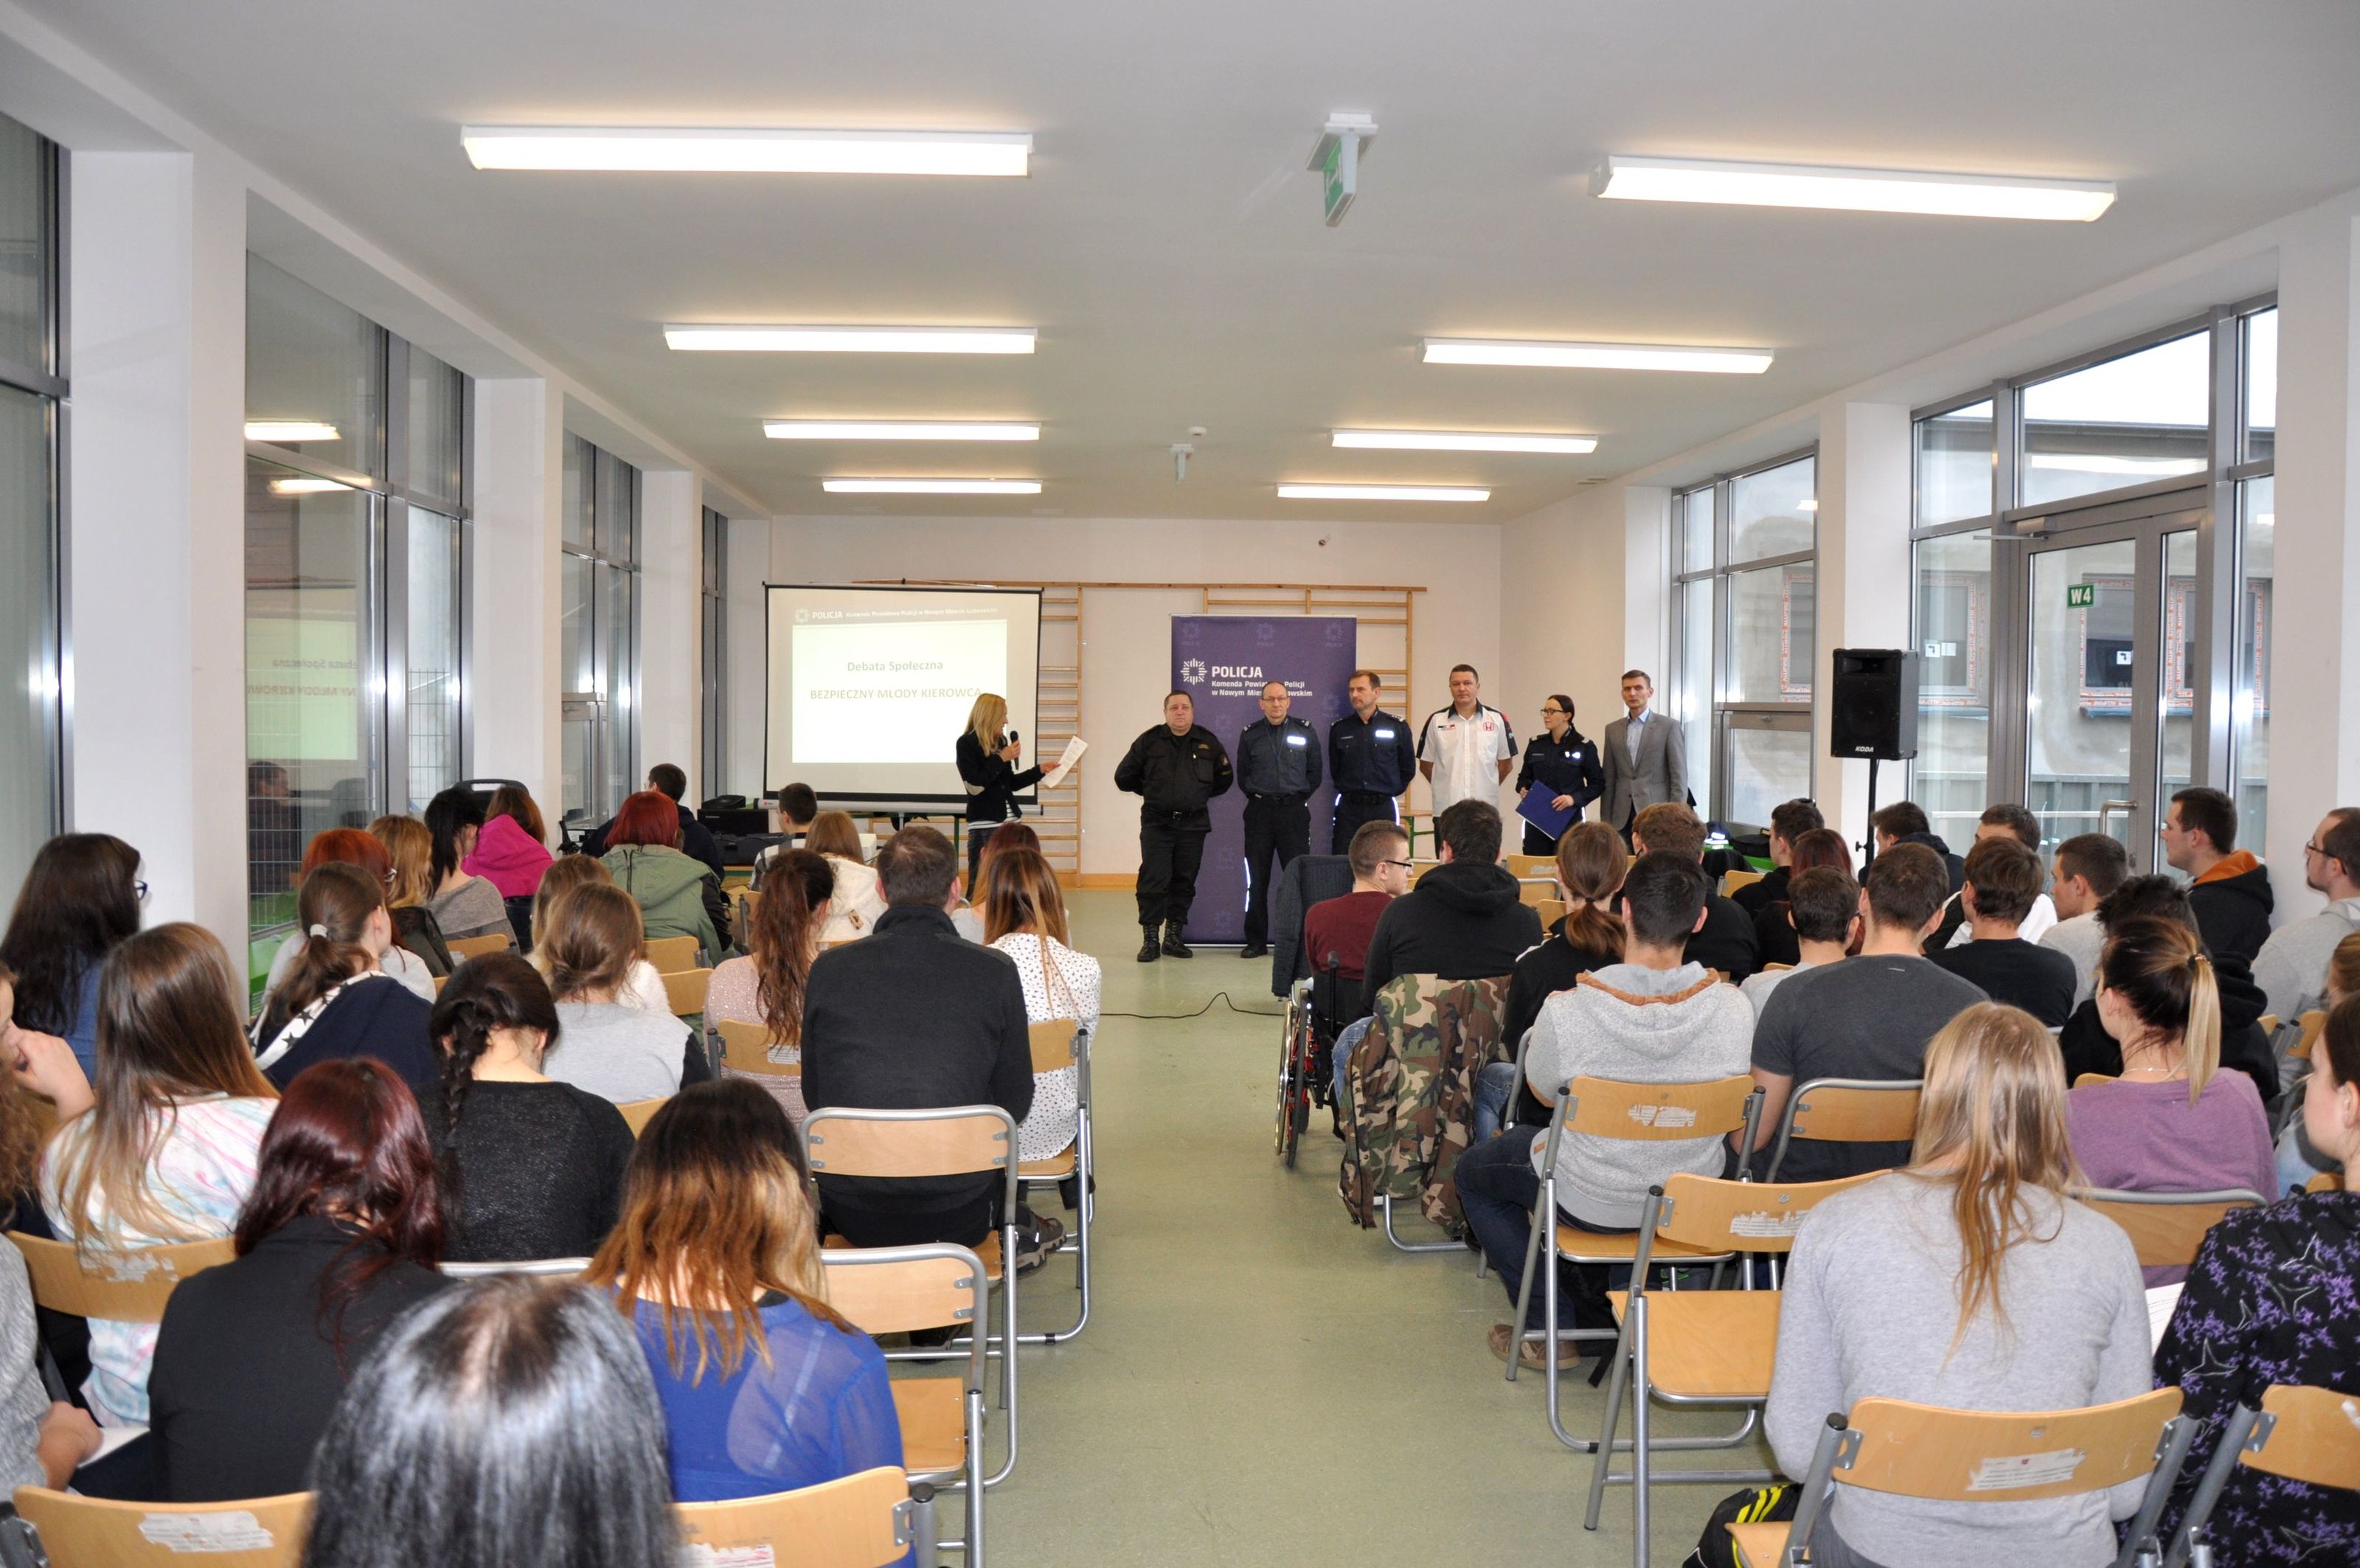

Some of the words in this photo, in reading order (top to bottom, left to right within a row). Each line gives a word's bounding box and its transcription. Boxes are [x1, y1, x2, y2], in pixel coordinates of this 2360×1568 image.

[2071, 587, 2092, 604] W4
[812, 611, 843, 619] POLICJA
[847, 662, 885, 671] Debata
[889, 661, 943, 672] Społeczna
[1212, 666, 1263, 678] POLICJA
[1284, 681, 1305, 689] Policji
[811, 690, 874, 699] BEZPIECZNY
[878, 689, 917, 698] MŁODY
[921, 687, 981, 698] KIEROWCA
